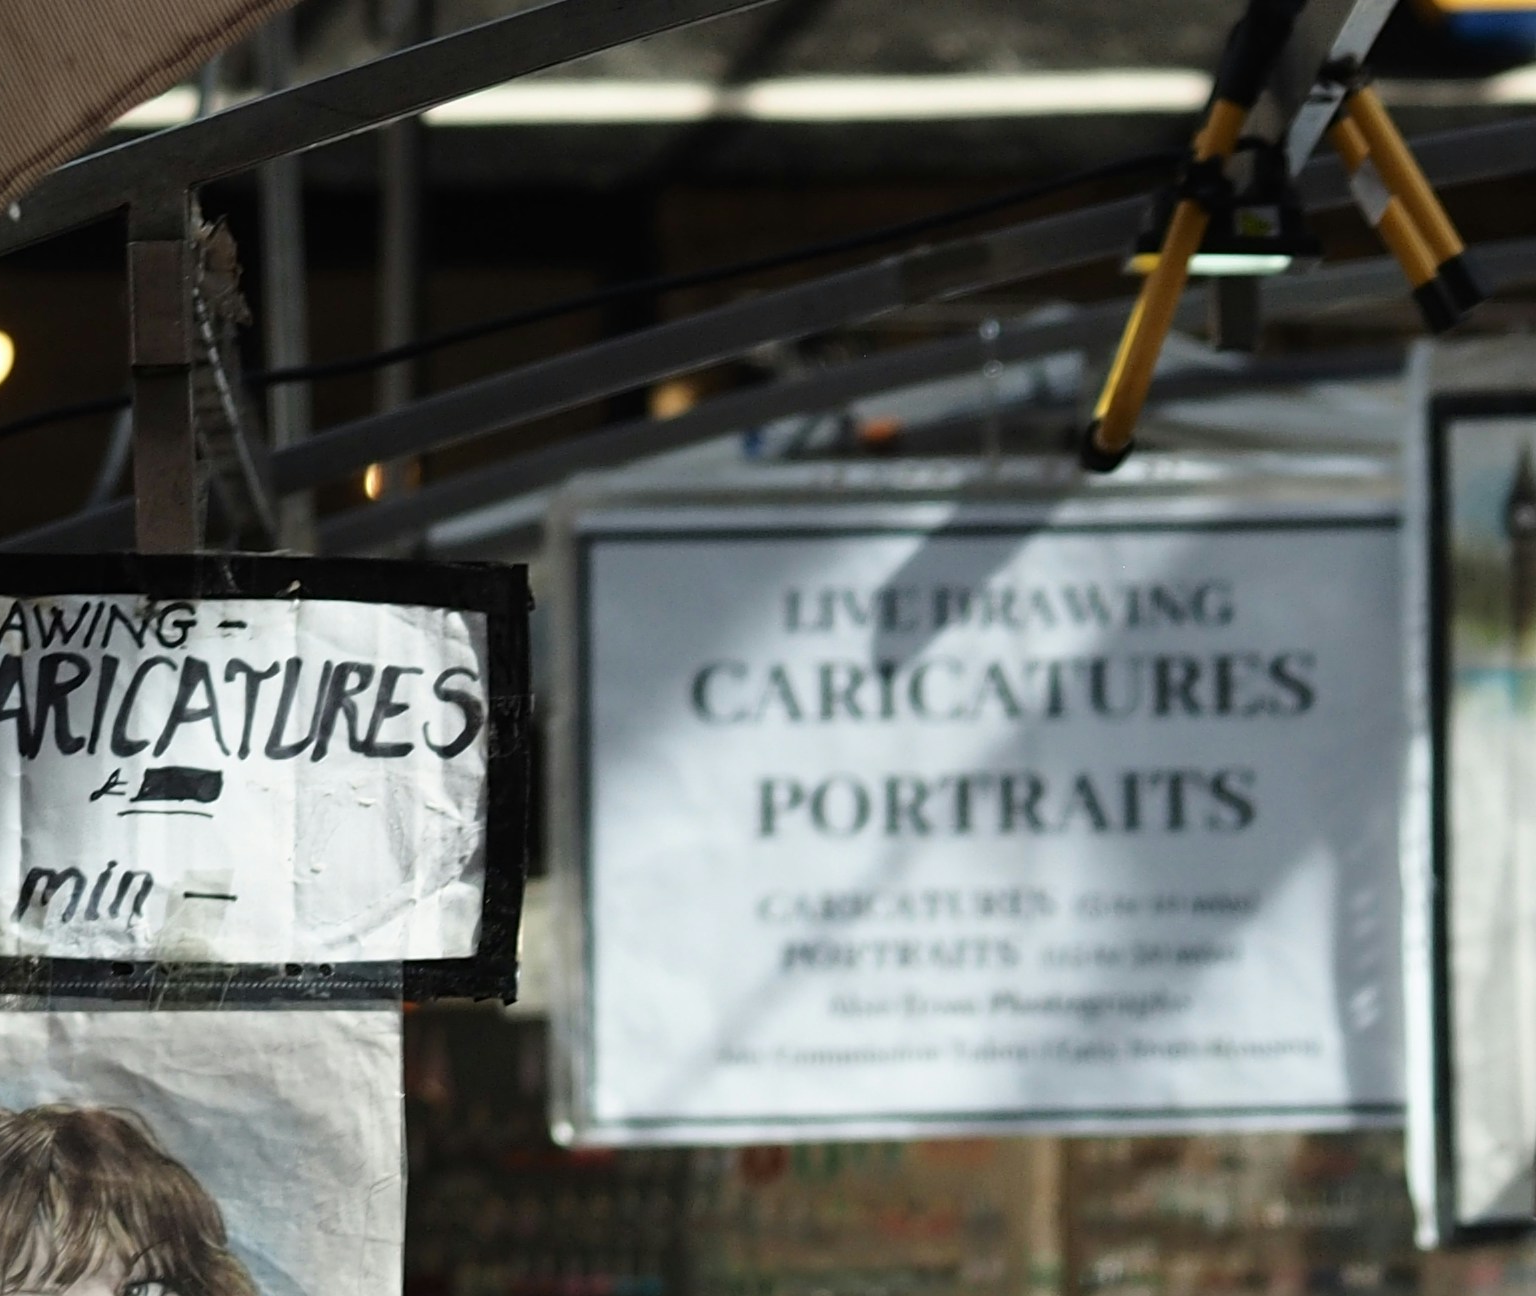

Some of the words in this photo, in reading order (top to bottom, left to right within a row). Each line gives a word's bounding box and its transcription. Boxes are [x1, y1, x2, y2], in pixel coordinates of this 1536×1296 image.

[784, 587, 923, 634] LIVE
[932, 583, 1235, 633] DRAWING
[689, 652, 1319, 726] CARICATURES
[753, 768, 1259, 840] PORTRAITS
[18, 860, 154, 923] min
